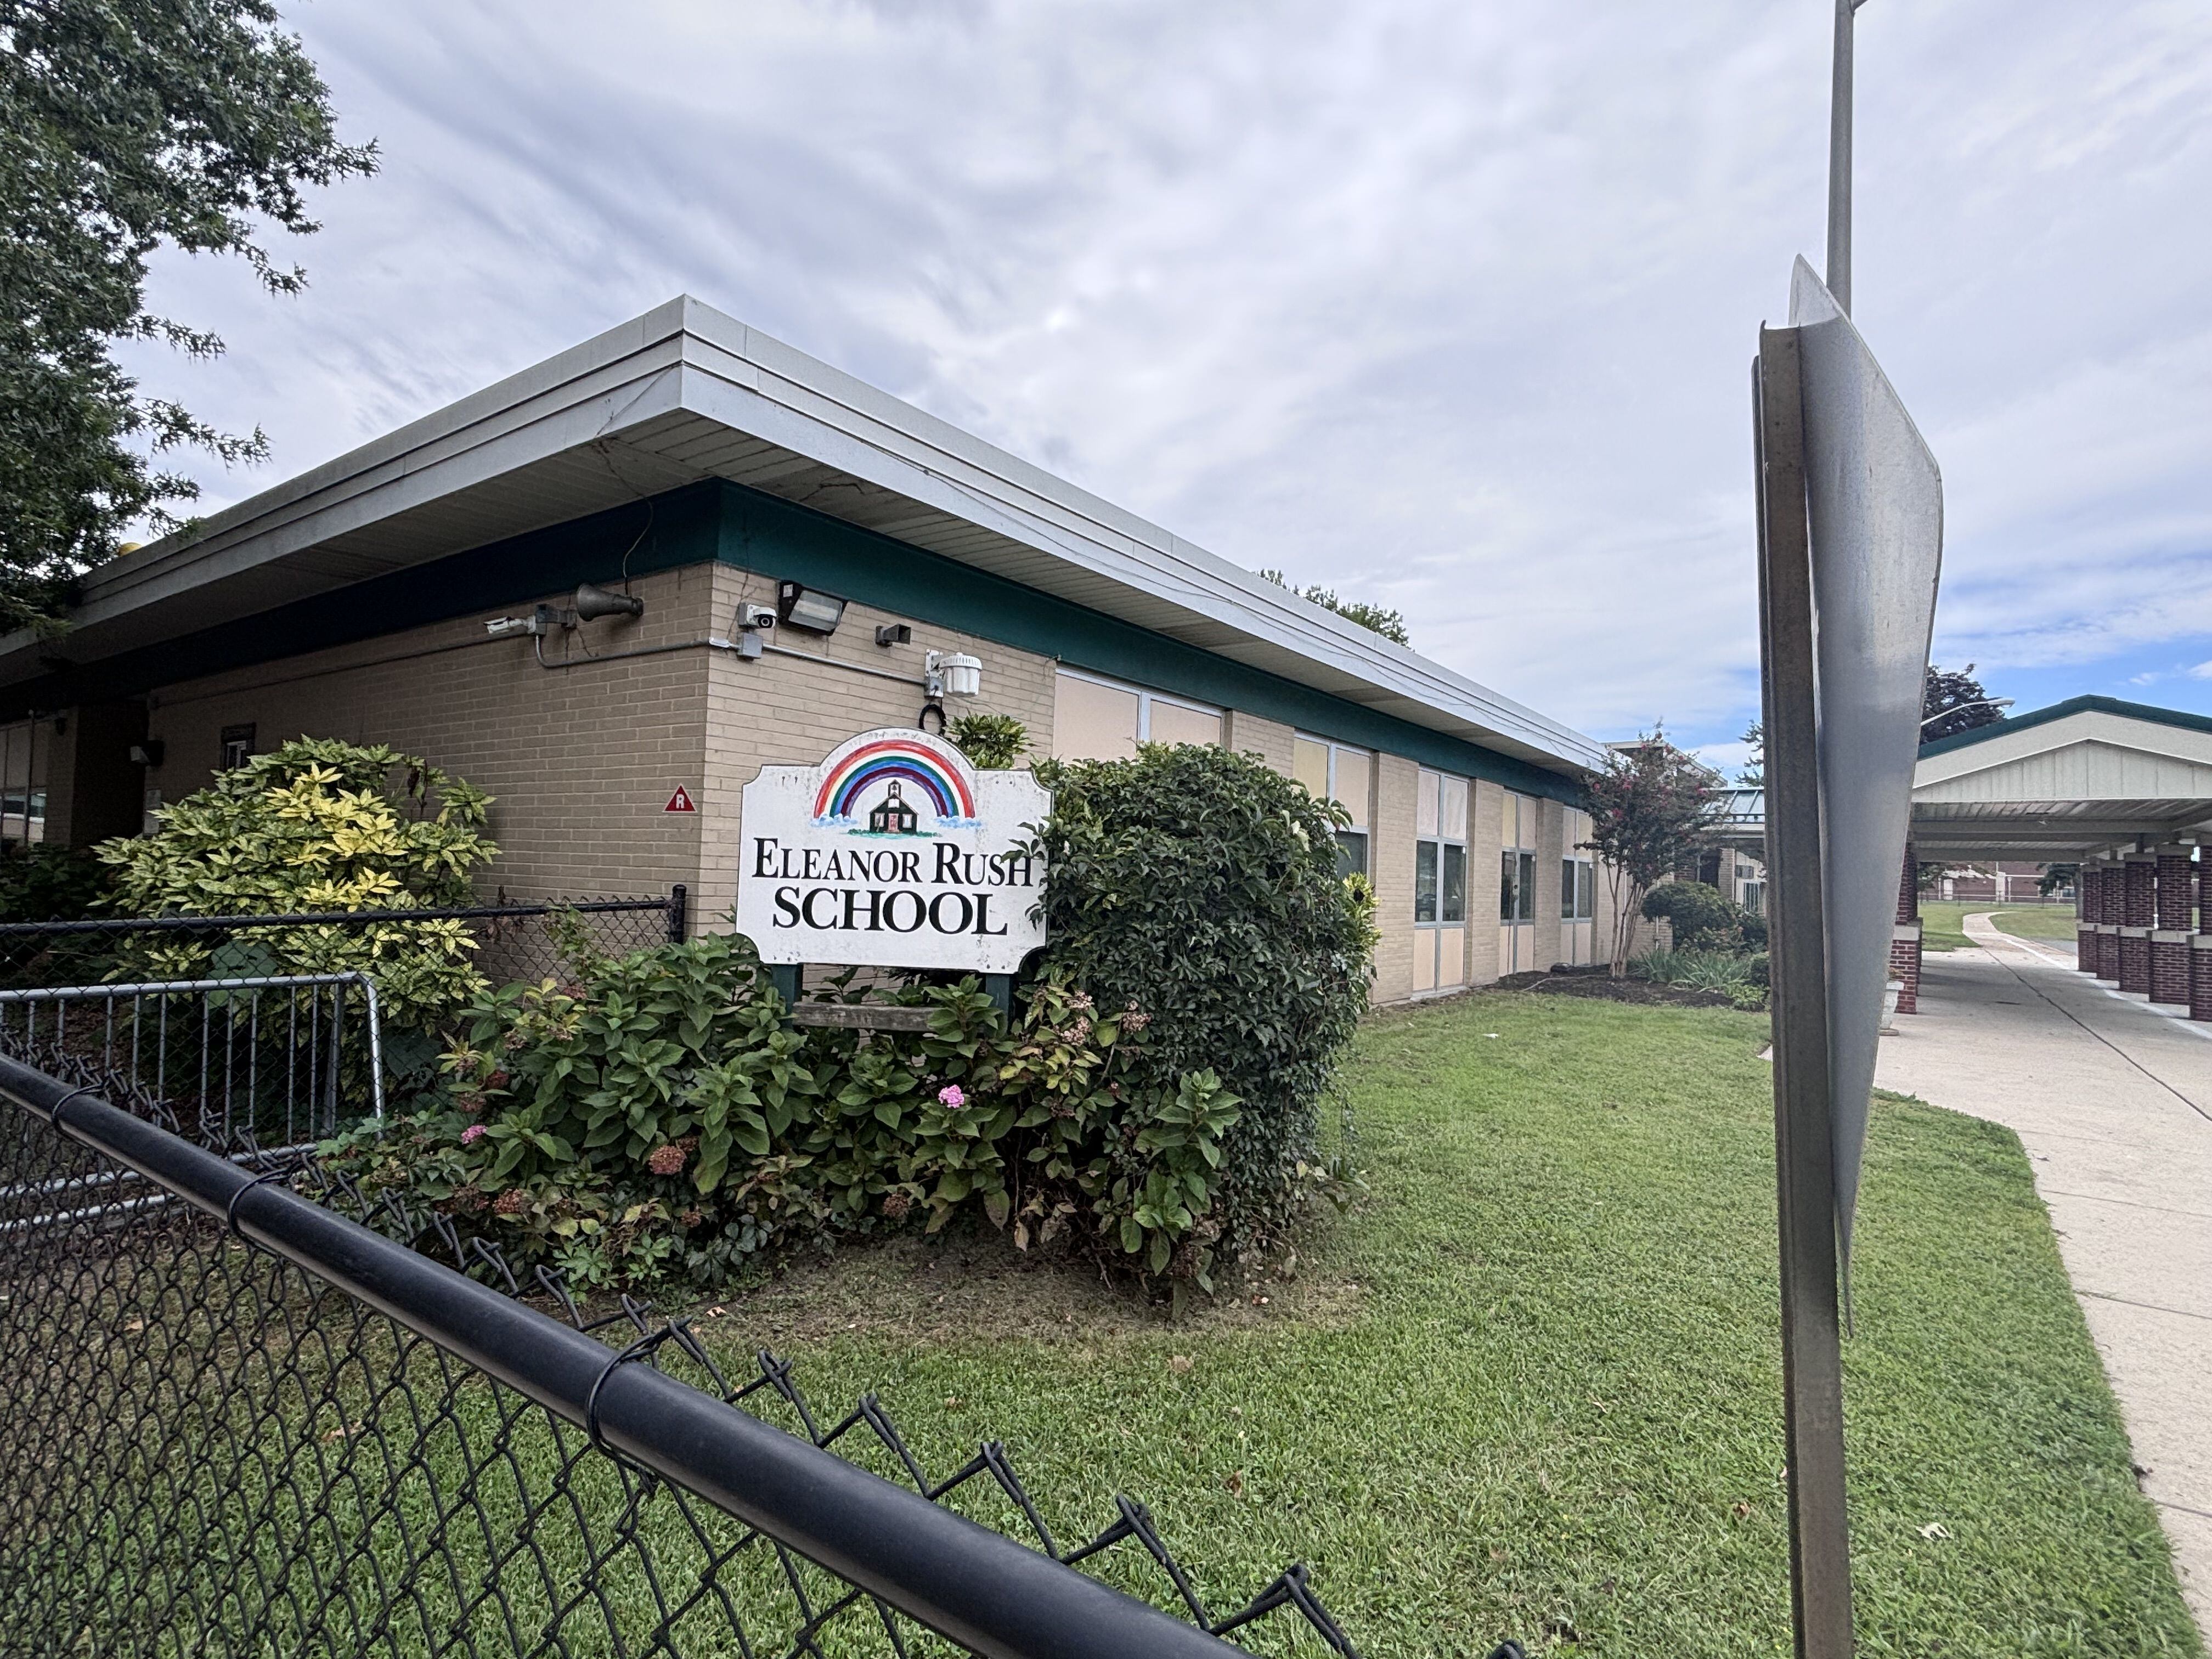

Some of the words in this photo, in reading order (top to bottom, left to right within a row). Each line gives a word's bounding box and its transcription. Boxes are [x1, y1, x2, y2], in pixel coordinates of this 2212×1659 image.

[752, 837, 923, 883] ELEANOR
[931, 842, 1034, 887] RUSH
[772, 885, 1008, 936] SCHOOL
